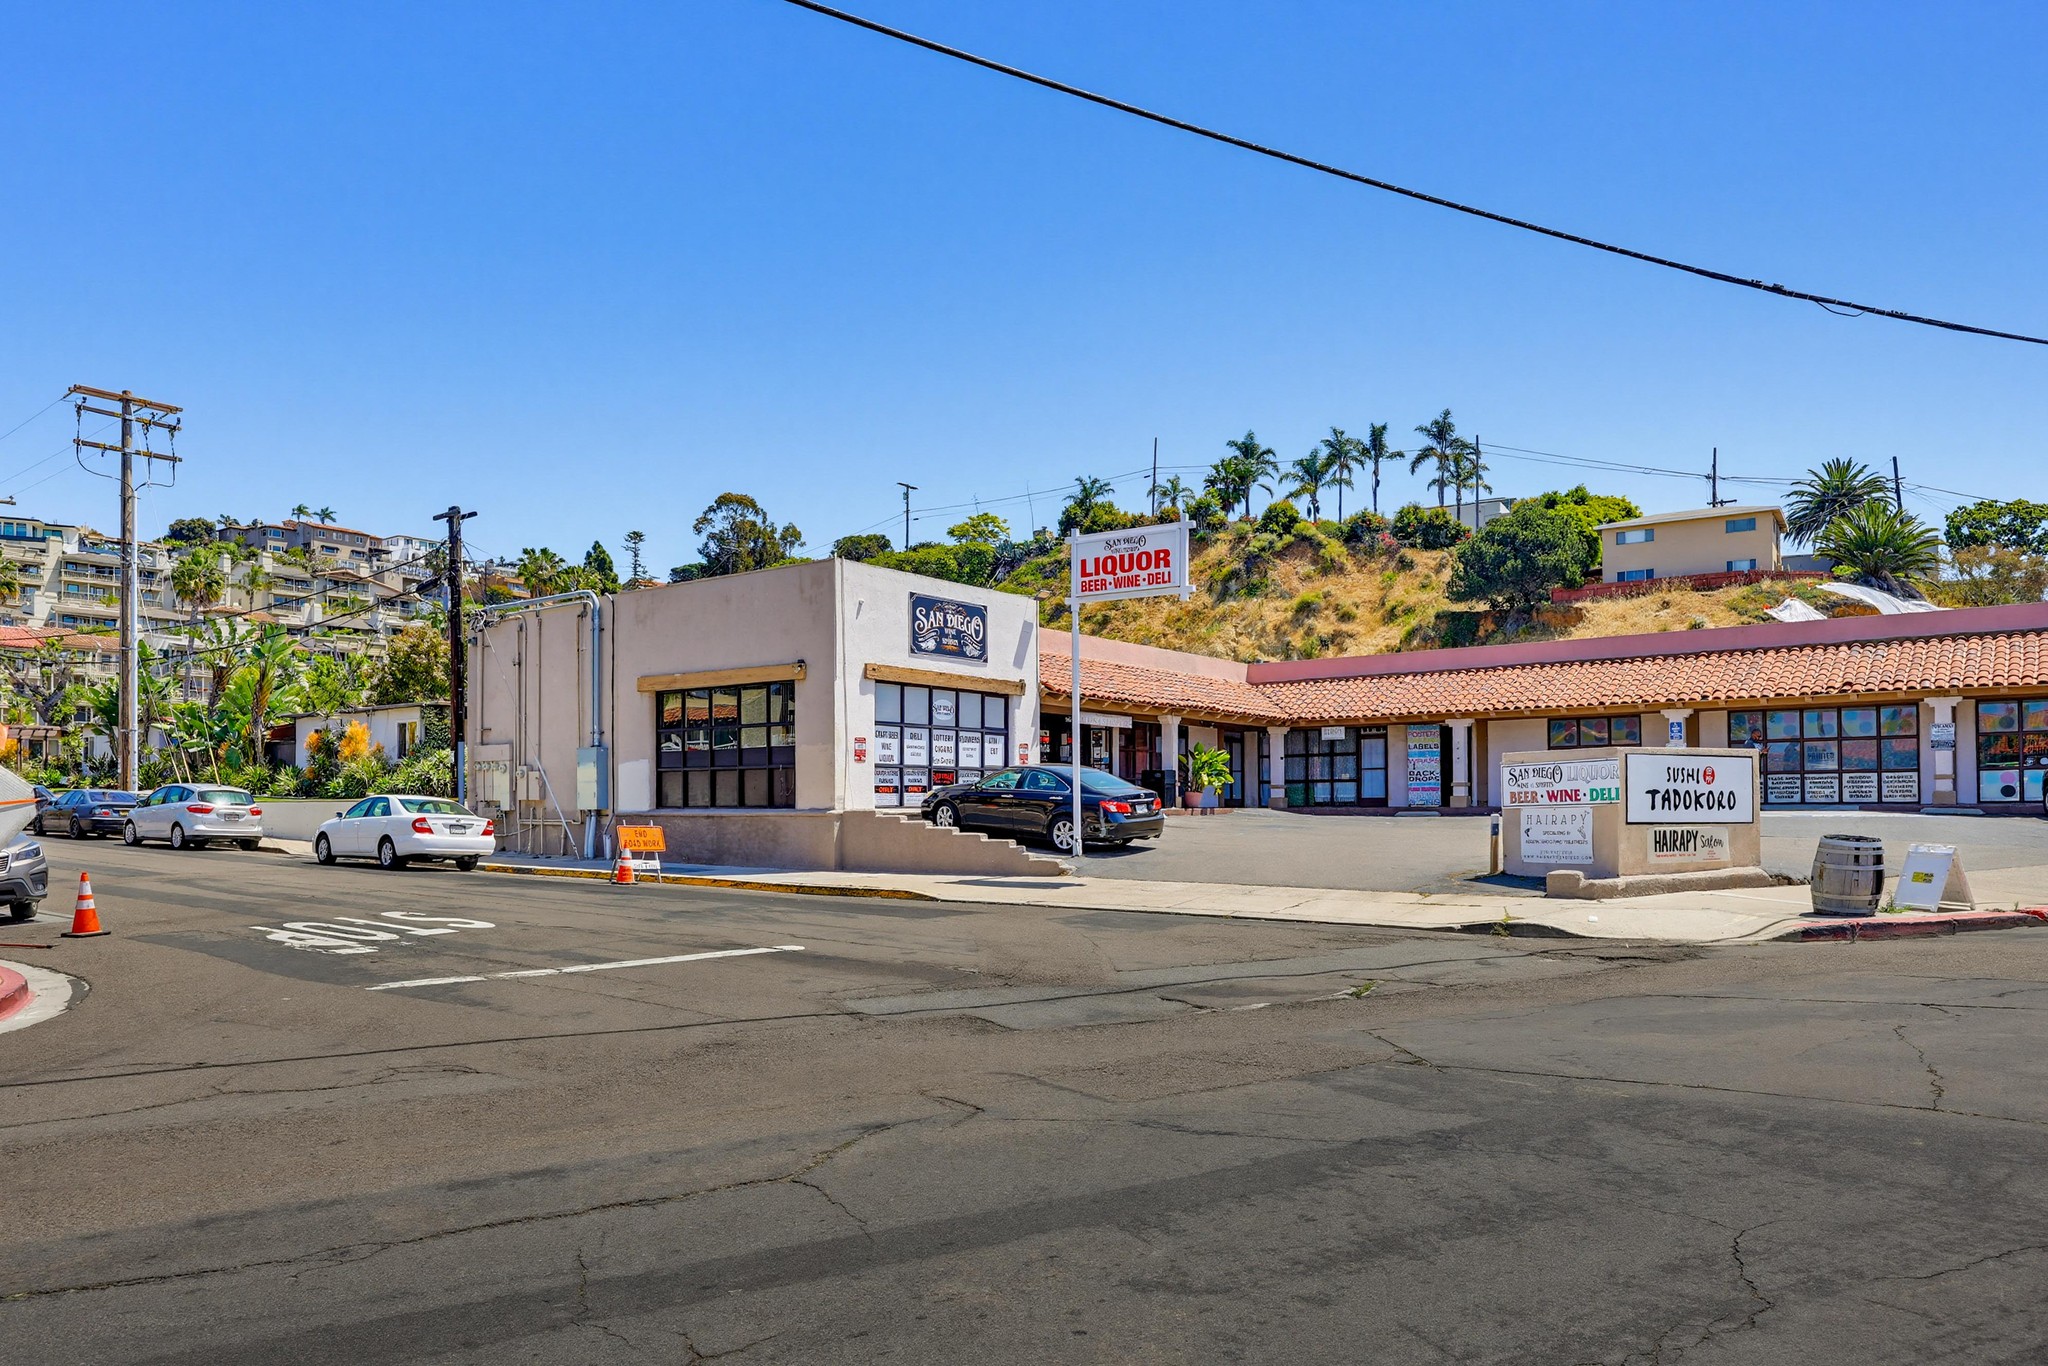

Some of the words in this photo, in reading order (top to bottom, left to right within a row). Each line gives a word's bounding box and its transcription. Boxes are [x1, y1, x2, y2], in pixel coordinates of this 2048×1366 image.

[1104, 539, 1121, 551] SAN
[1123, 534, 1147, 548] DIEGO
[1080, 548, 1171, 578] LIQUOR
[1081, 578, 1108, 593] BEER
[1113, 574, 1141, 589] WINE
[1147, 571, 1172, 585] DELI
[914, 607, 944, 634] SAN
[946, 614, 984, 641] DIEGO
[910, 732, 923, 740] DELI
[933, 734, 954, 742] LOTTERY
[881, 742, 892, 751] WINE
[934, 745, 953, 753] CIGARS
[1507, 767, 1530, 787] SAN
[1532, 764, 1563, 784] DIEGO
[1566, 763, 1620, 784] LIQUOR
[1666, 766, 1700, 784] SUSHI
[1509, 791, 1539, 804] BEER
[1546, 788, 1581, 803] WINE
[1589, 787, 1620, 801] DELI
[1645, 788, 1737, 811] TADOKORO
[1526, 814, 1587, 825] HAIRAPY
[634, 830, 648, 838] END
[1654, 830, 1699, 853] HAIRAPY
[1700, 835, 1724, 849] Salon
